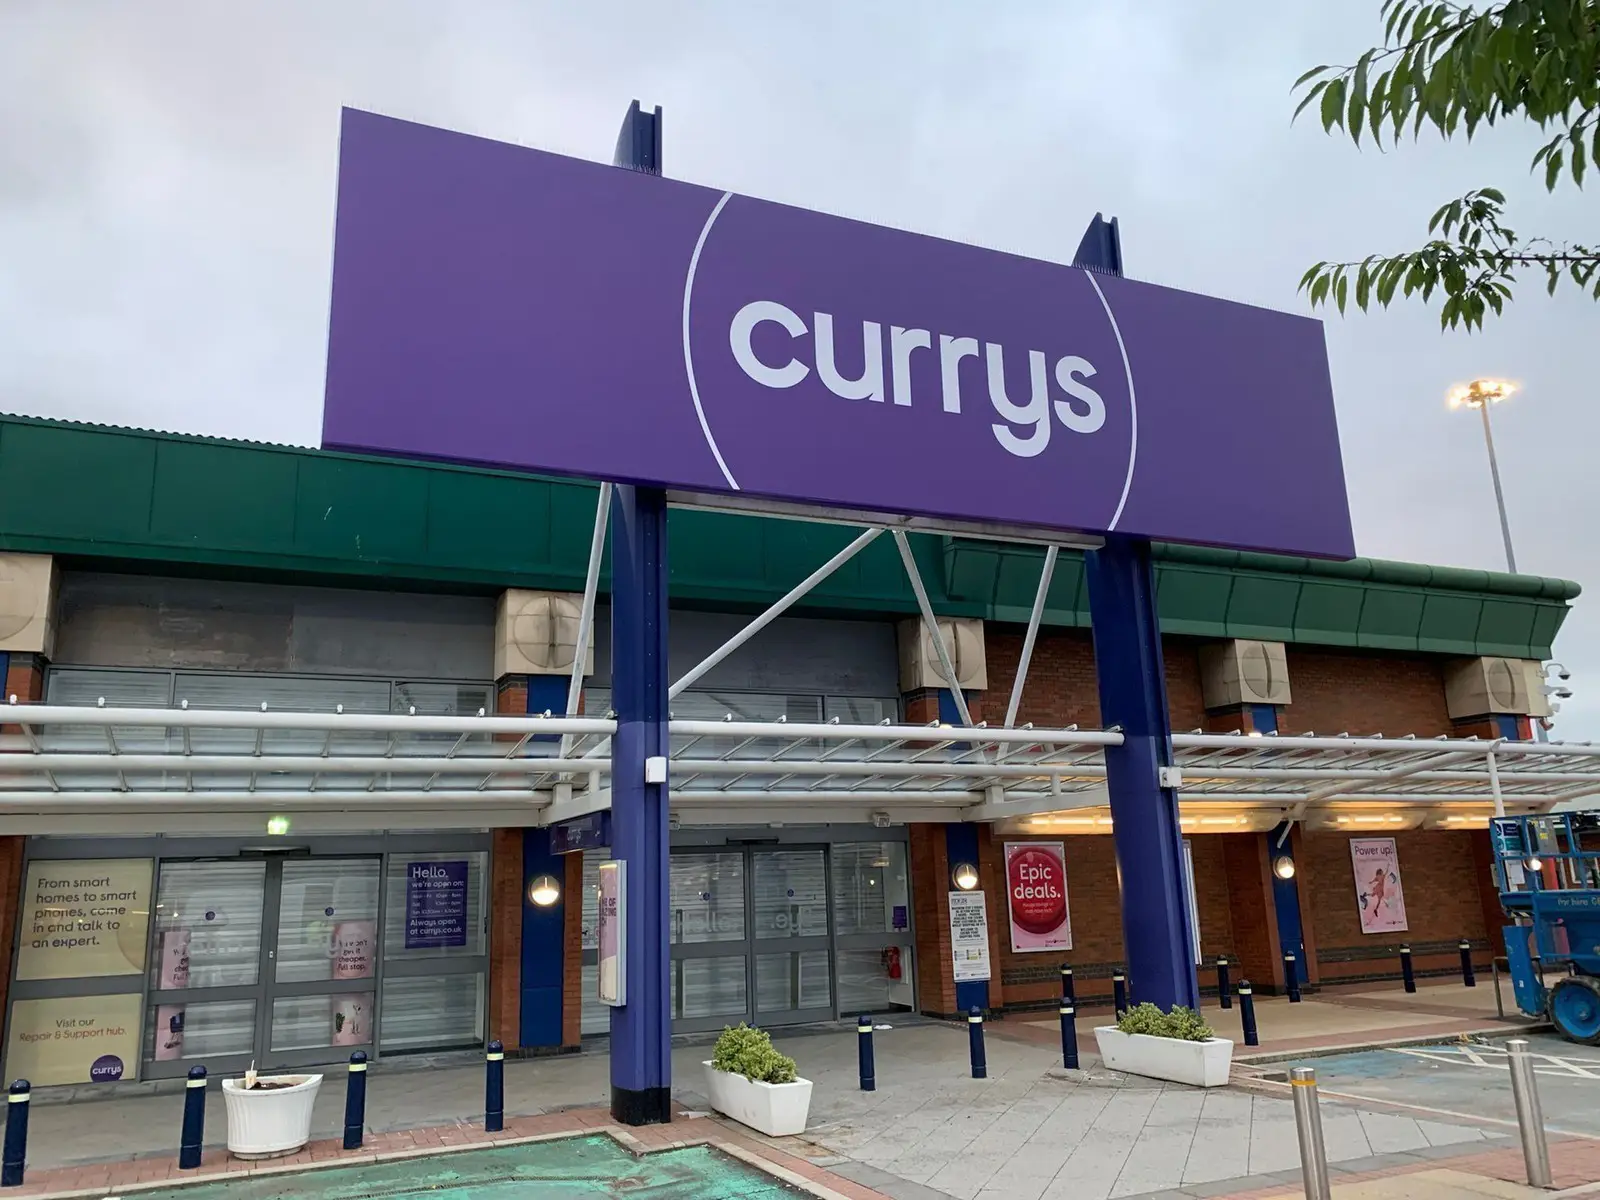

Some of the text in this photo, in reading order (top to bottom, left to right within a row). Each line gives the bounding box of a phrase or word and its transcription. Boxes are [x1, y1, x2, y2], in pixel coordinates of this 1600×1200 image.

[729, 300, 1107, 458] currys
[1354, 845, 1379, 856] Power
[412, 866, 449, 879] Hello.
[1020, 863, 1052, 884] Epic
[37, 877, 110, 889] From smart
[412, 880, 431, 888] we're
[433, 880, 452, 889] open
[36, 890, 136, 904] homes to smart
[1014, 882, 1061, 899] deals.
[34, 906, 126, 920] phones, come
[33, 920, 120, 933] in and talk to
[410, 919, 436, 927] Always
[31, 936, 100, 949] an expert.
[56, 1019, 95, 1028] Visit our
[19, 1027, 127, 1043] Repair & Support hub.
[92, 1064, 122, 1077] currys
